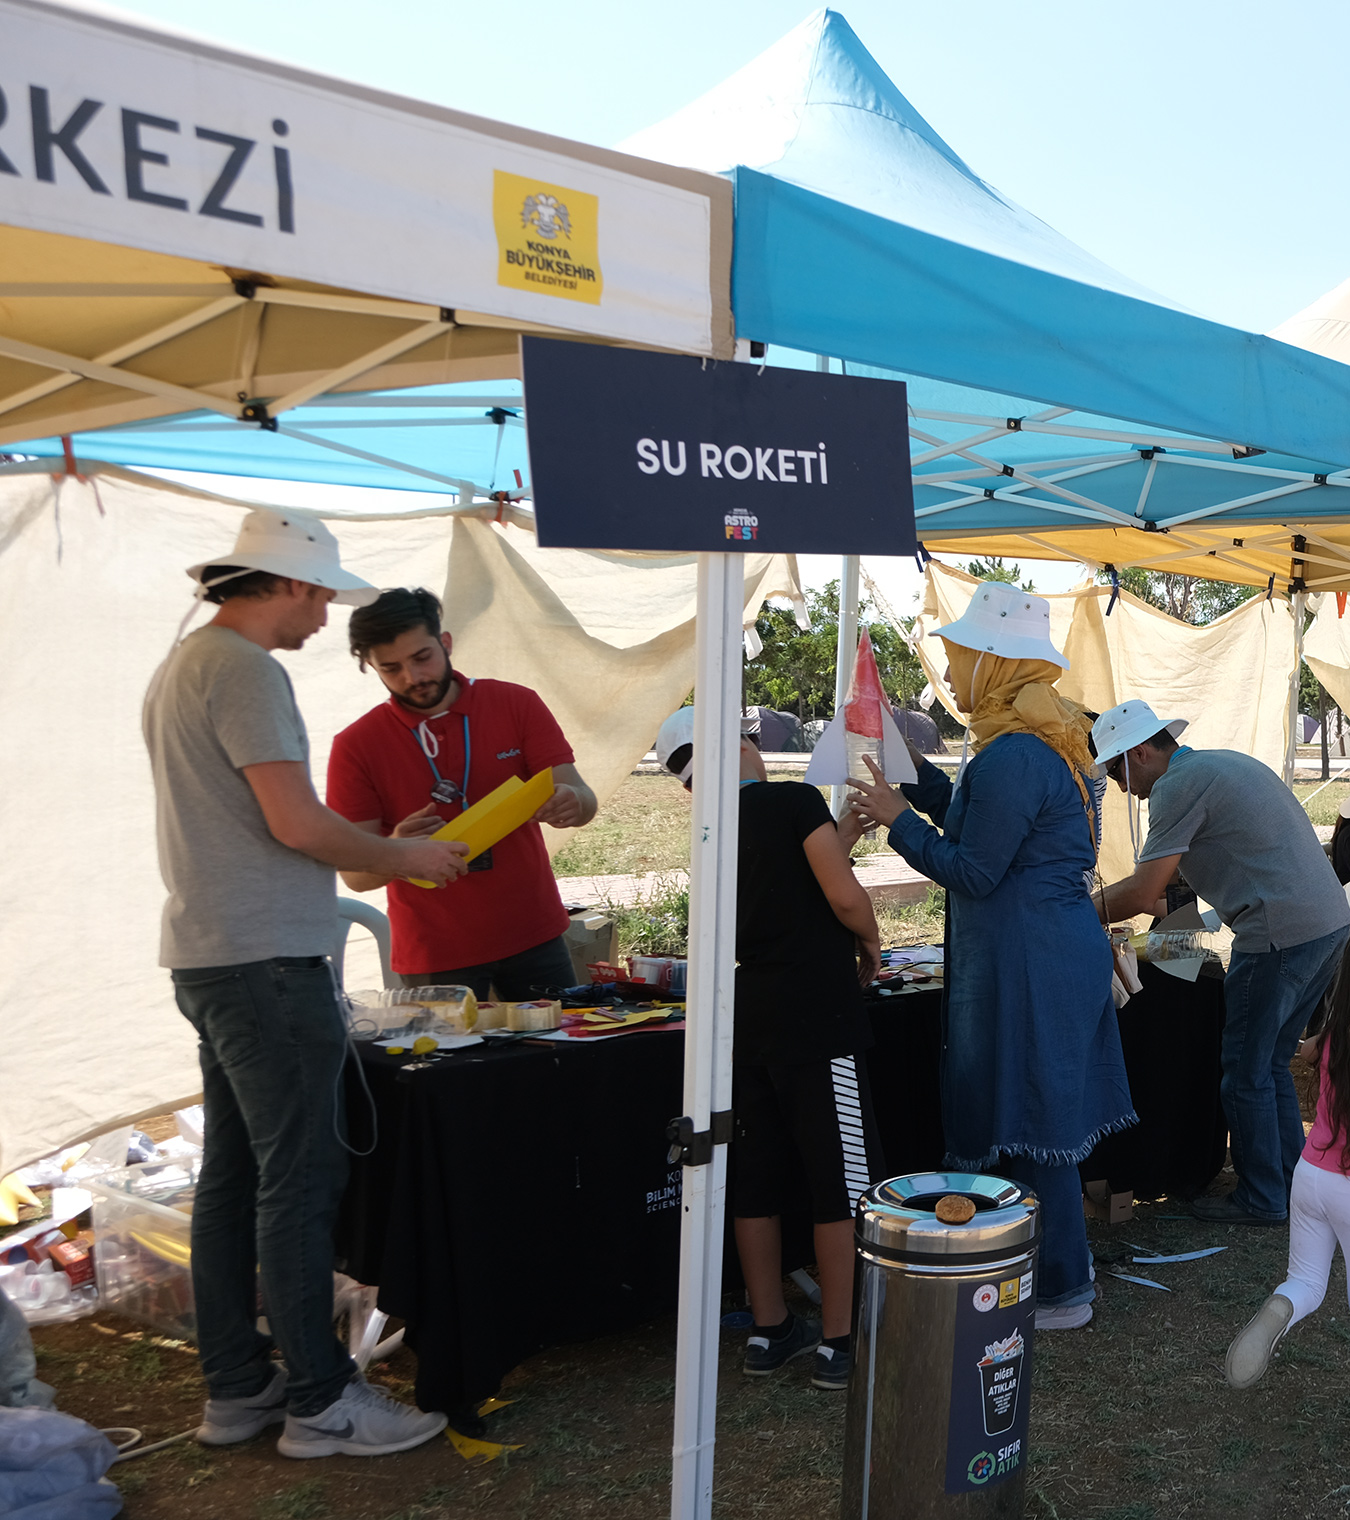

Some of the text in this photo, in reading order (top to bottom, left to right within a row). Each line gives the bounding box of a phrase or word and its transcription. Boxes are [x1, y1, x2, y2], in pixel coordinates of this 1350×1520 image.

[526, 240, 572, 260] KONYA
[506, 248, 596, 282] BÜYÜKŞEHİR
[636, 437, 828, 484] SU ROKETİ
[724, 515, 758, 527] ASTRO
[725, 526, 759, 540] FEST
[646, 1197, 682, 1214] SCIENC
[994, 1366, 1014, 1382] DİĞER
[988, 1378, 1017, 1397] ATIKLAR
[997, 1438, 1021, 1462] SIFIR
[996, 1452, 1020, 1476] ATIK
